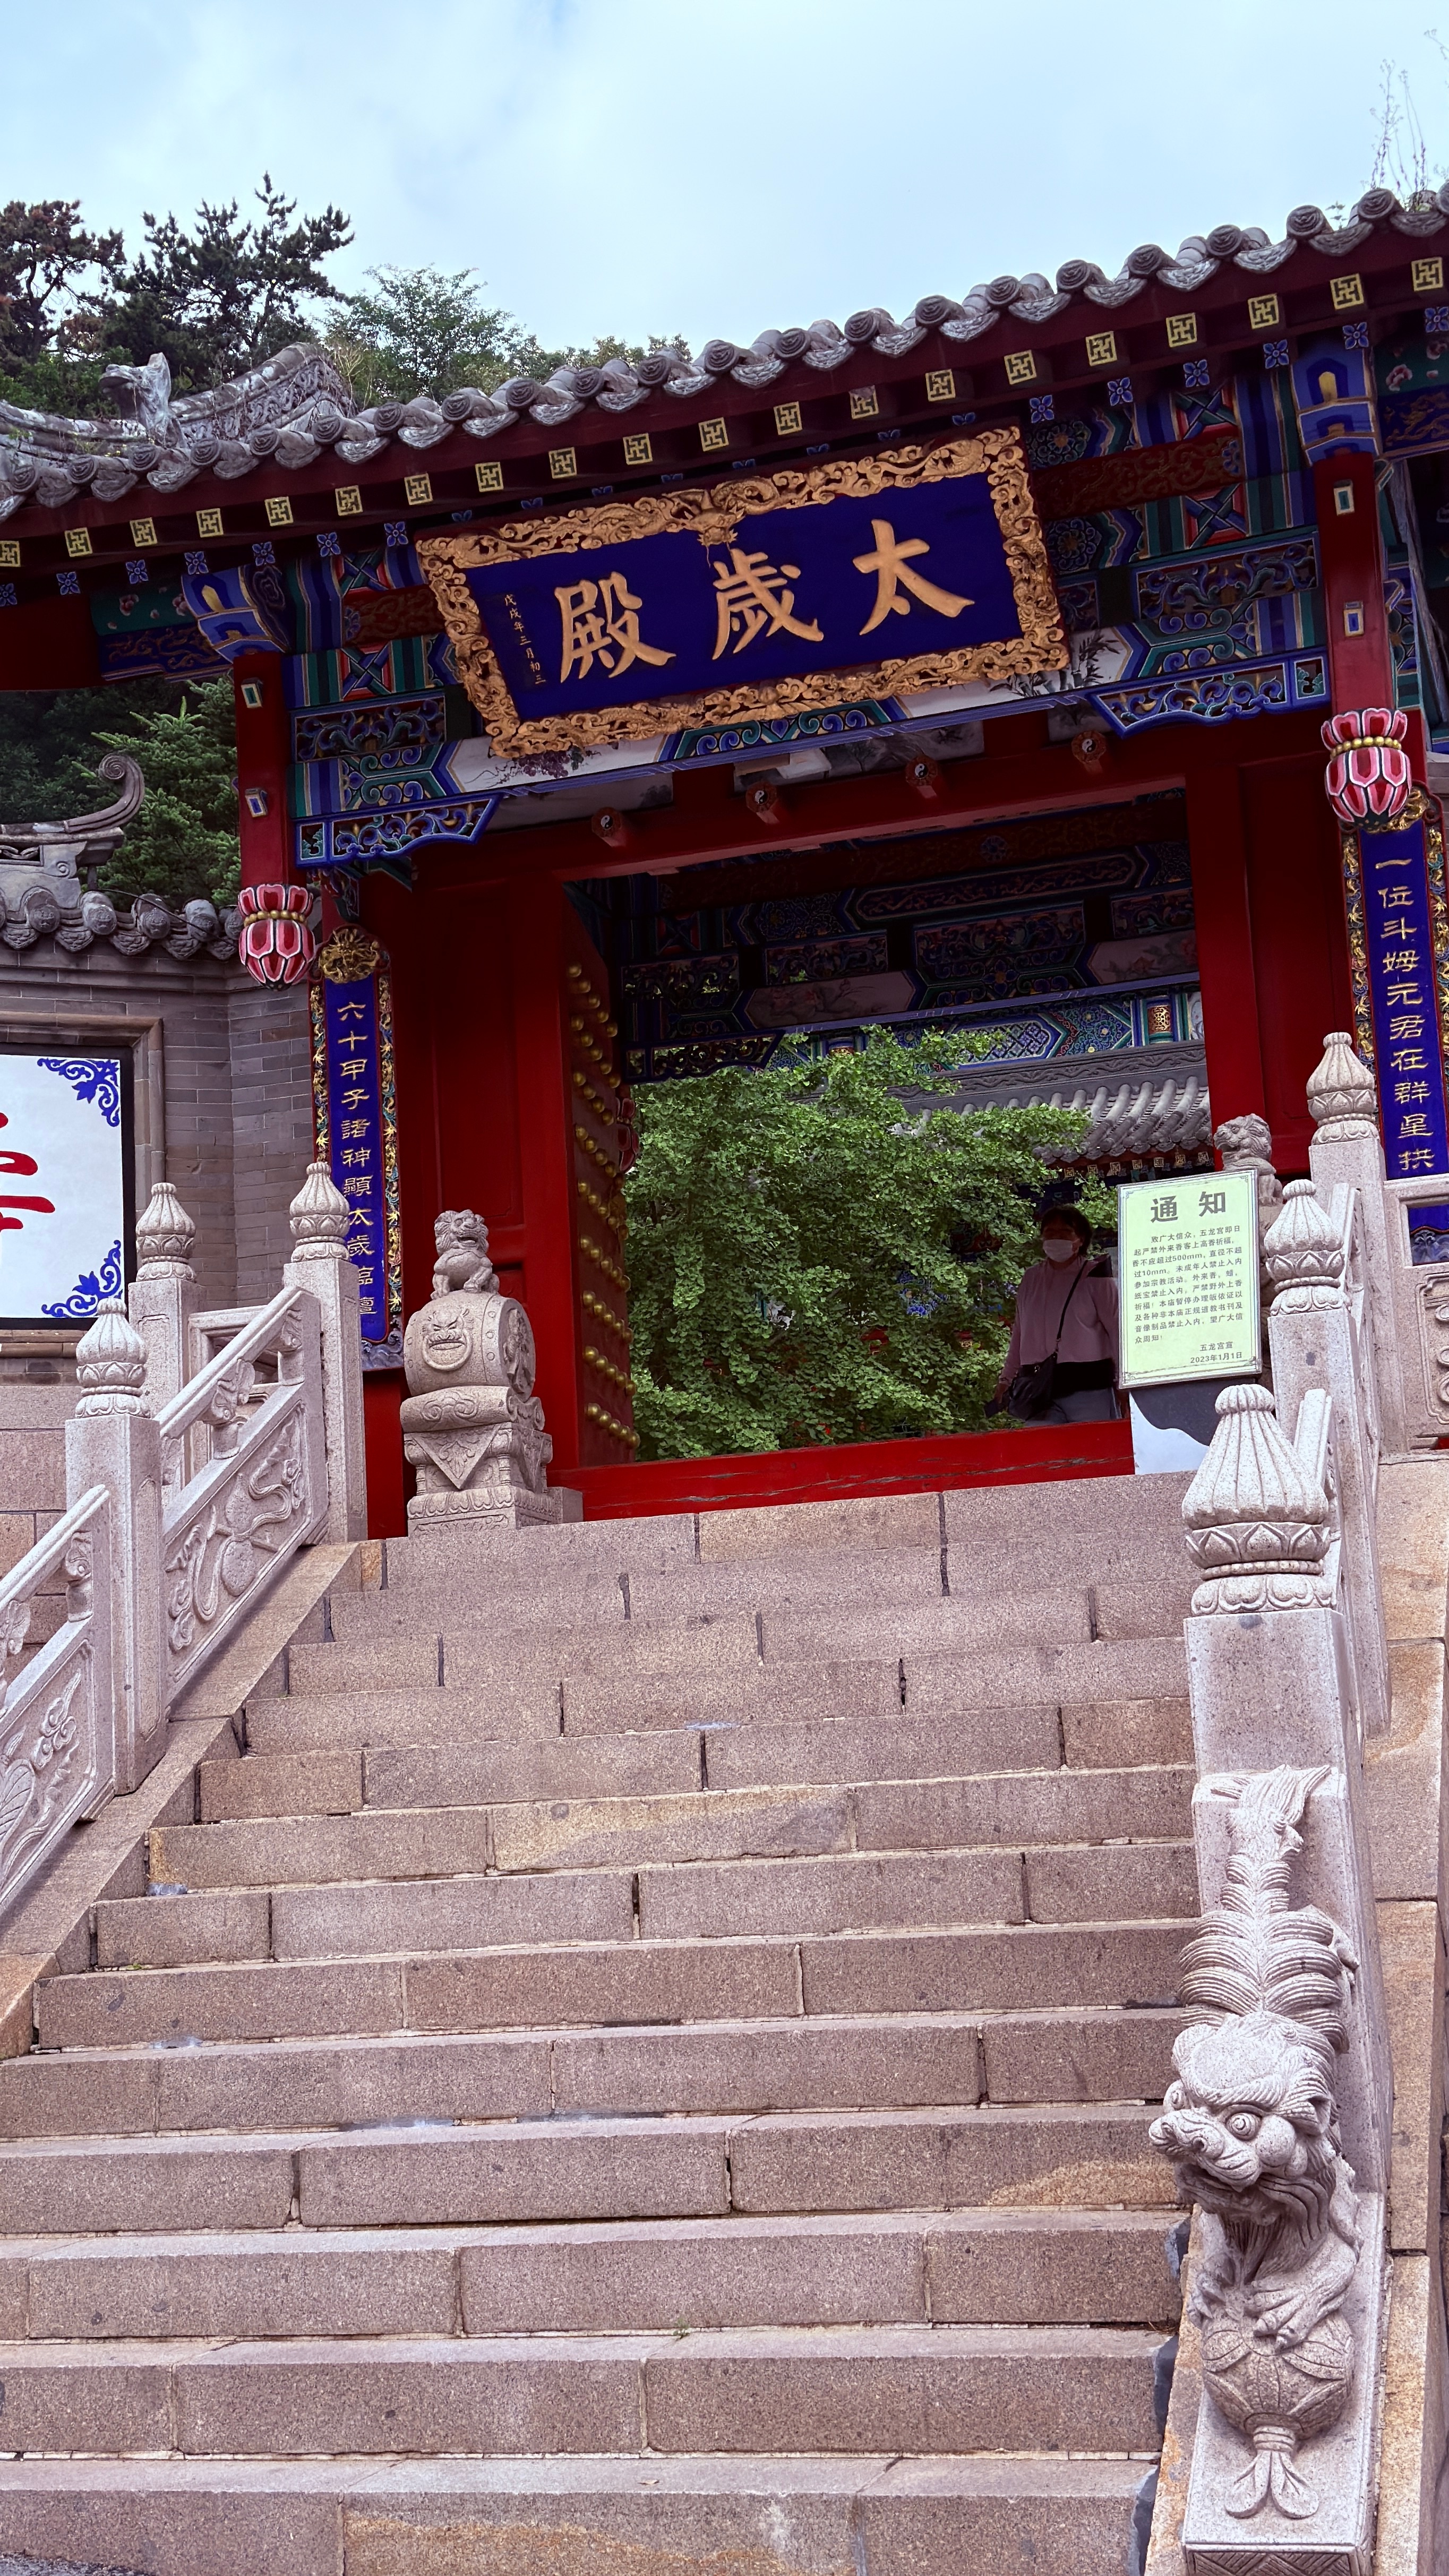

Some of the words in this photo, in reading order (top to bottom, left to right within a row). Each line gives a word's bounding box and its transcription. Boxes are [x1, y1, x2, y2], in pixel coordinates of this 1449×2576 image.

[554, 518, 975, 684] 太歲殿
[1150, 1191, 1227, 1223] 通知
[1190, 1352, 1242, 1363] 2023年1月1日
